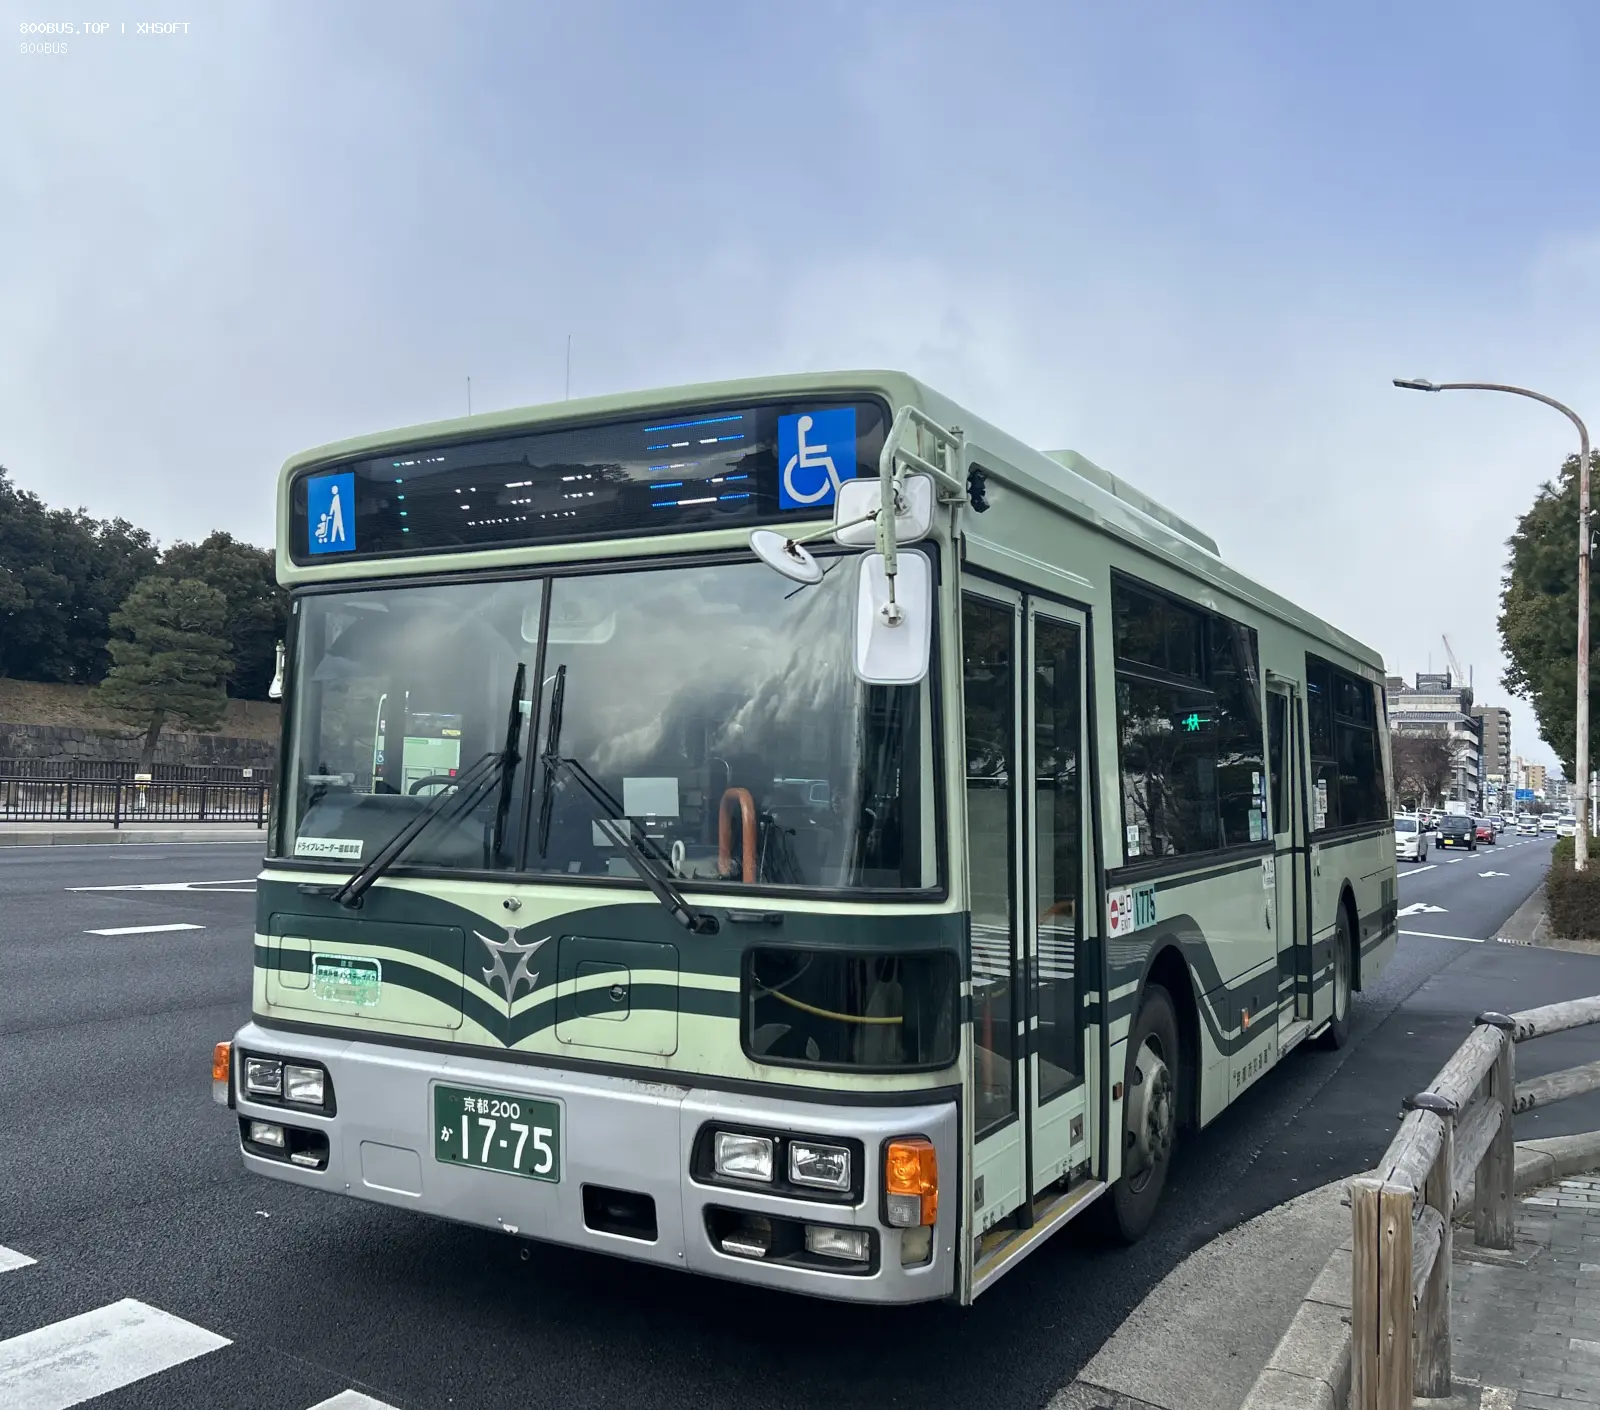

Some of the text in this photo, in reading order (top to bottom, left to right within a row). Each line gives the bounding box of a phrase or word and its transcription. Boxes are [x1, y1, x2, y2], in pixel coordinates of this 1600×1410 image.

[1121, 917, 1131, 931] EXIT
[1135, 888, 1156, 926] 1775
[440, 1114, 553, 1174] か 17-75
